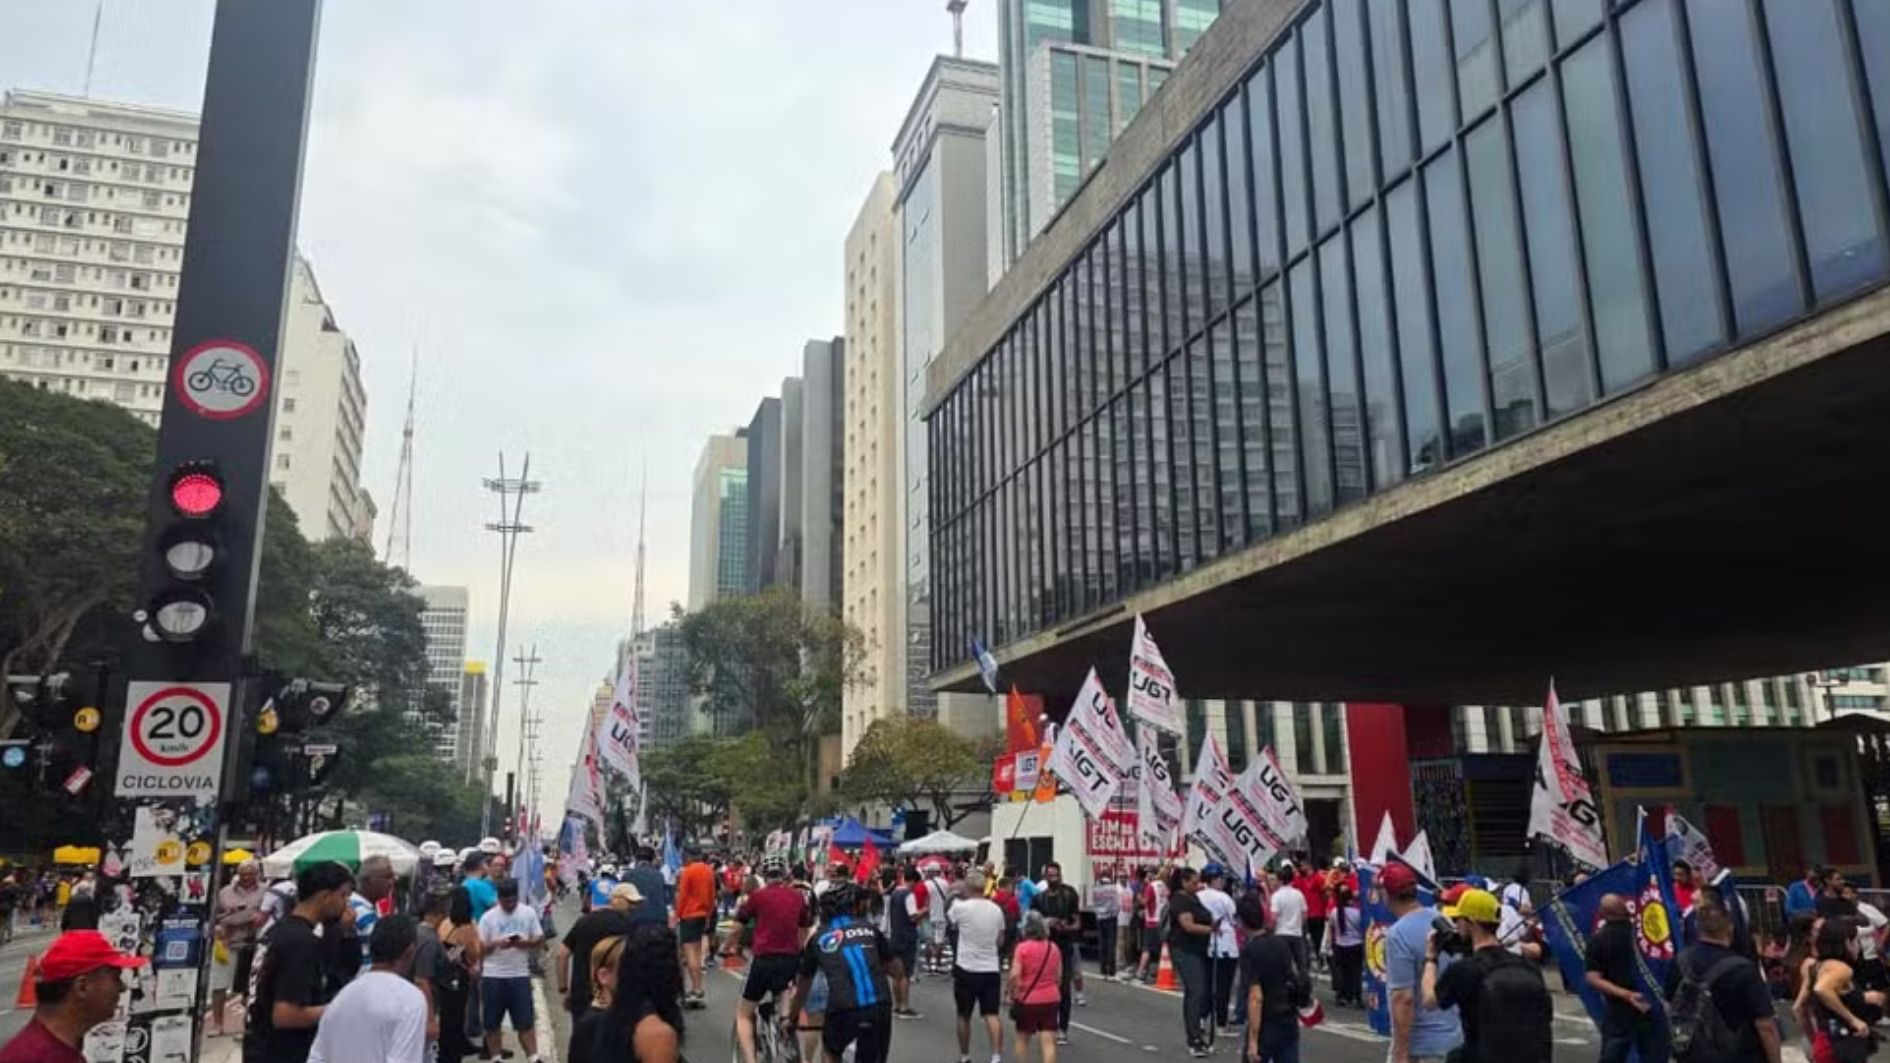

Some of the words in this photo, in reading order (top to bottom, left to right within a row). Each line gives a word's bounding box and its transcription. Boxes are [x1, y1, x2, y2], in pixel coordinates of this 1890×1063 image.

[148, 705, 204, 739] 20
[160, 743, 189, 753] km/h
[123, 775, 214, 789] CICLOVIA
[1260, 764, 1302, 816] UGT
[1222, 807, 1267, 856] UGT
